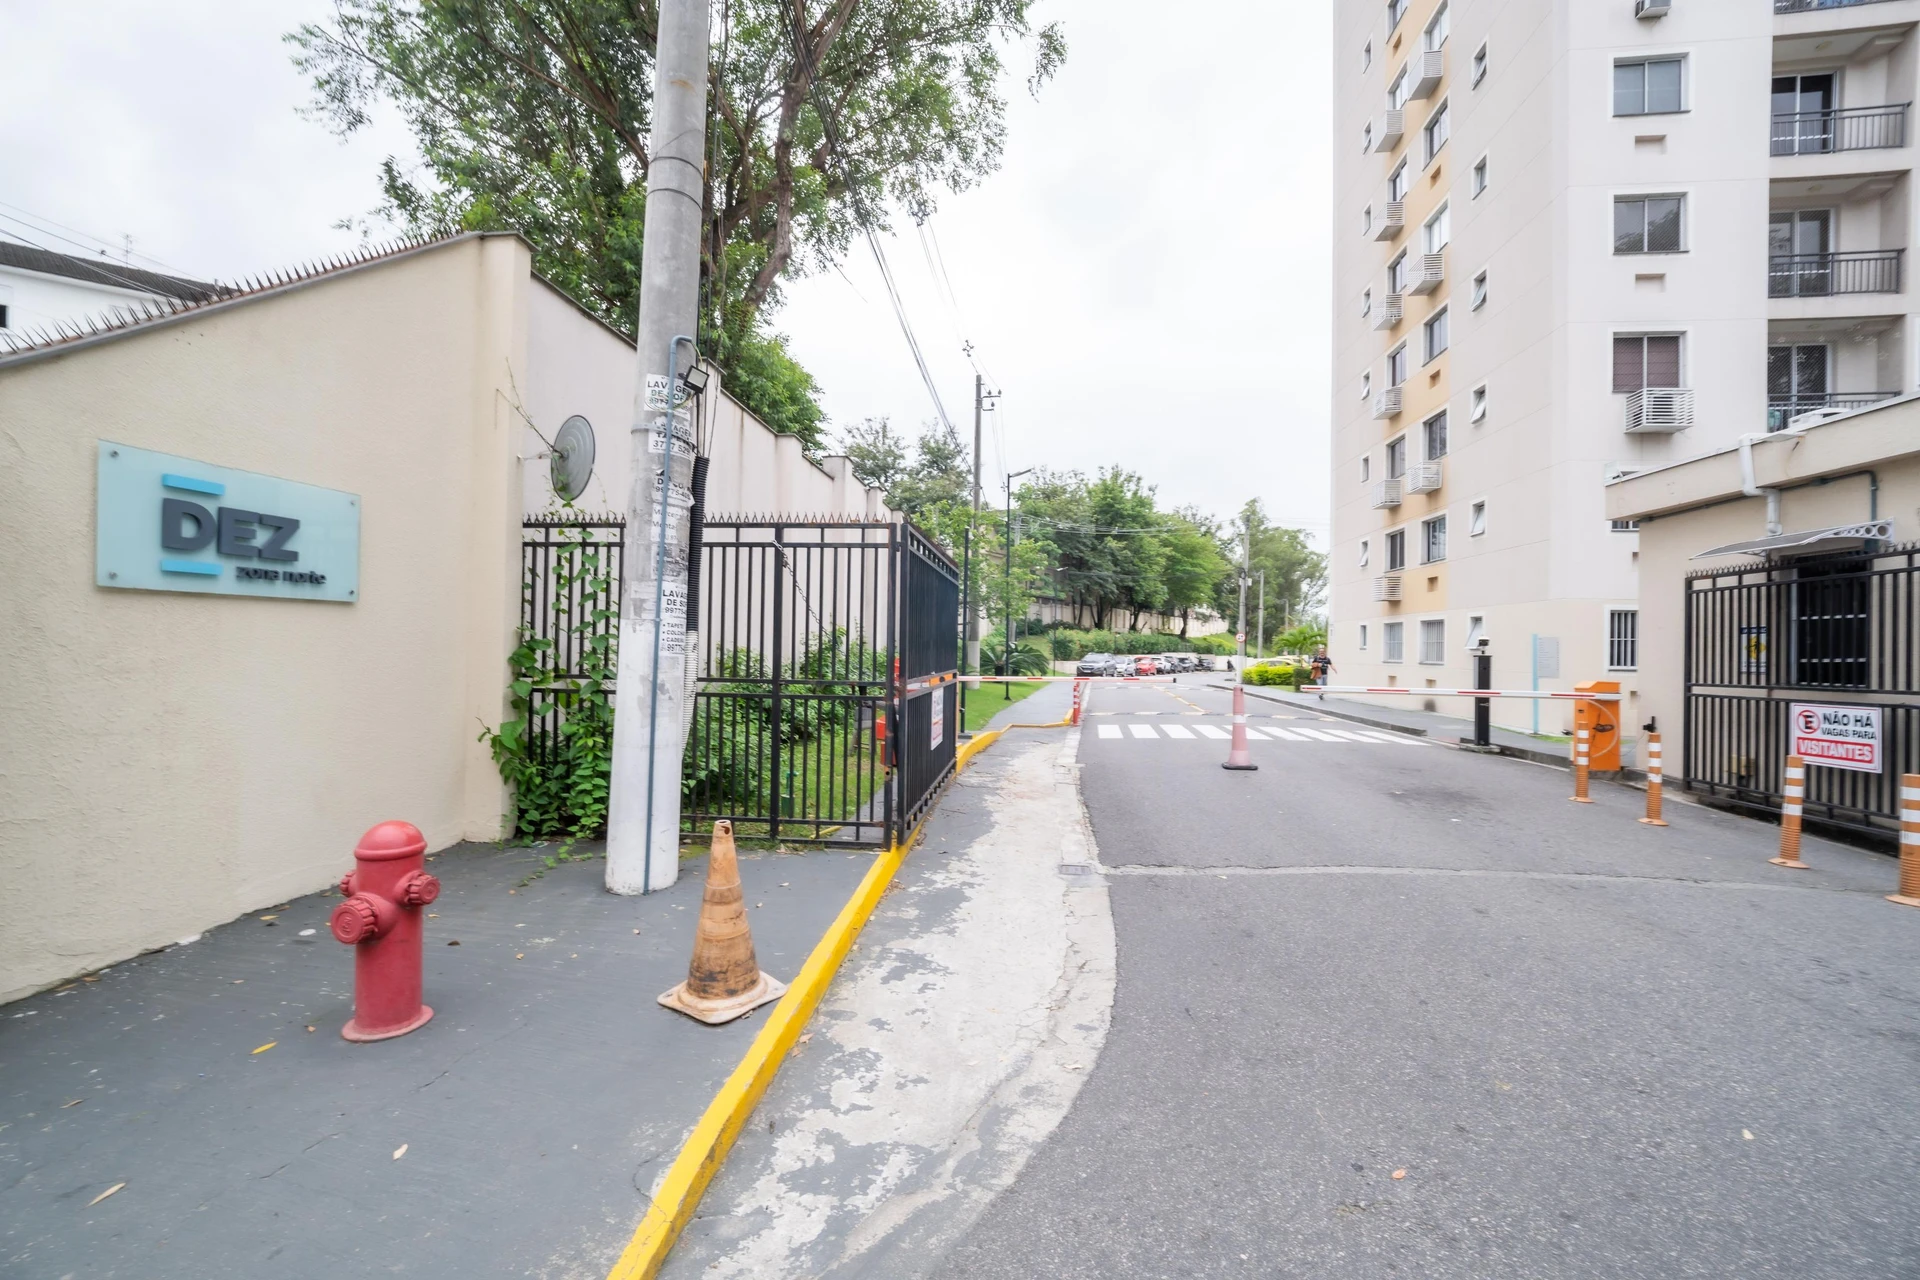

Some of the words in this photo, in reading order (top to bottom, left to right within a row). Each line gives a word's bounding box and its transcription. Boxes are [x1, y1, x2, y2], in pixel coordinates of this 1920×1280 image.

[161, 497, 300, 562] DEZ
[235, 566, 280, 581] zona
[282, 570, 327, 585] norte
[666, 598, 678, 606] DE
[1822, 710, 1850, 726] NÃO
[1854, 712, 1874, 728] HÁ
[1821, 727, 1850, 738] VAGAS
[1852, 729, 1877, 740] PARA
[1799, 740, 1872, 761] VISITANTES
